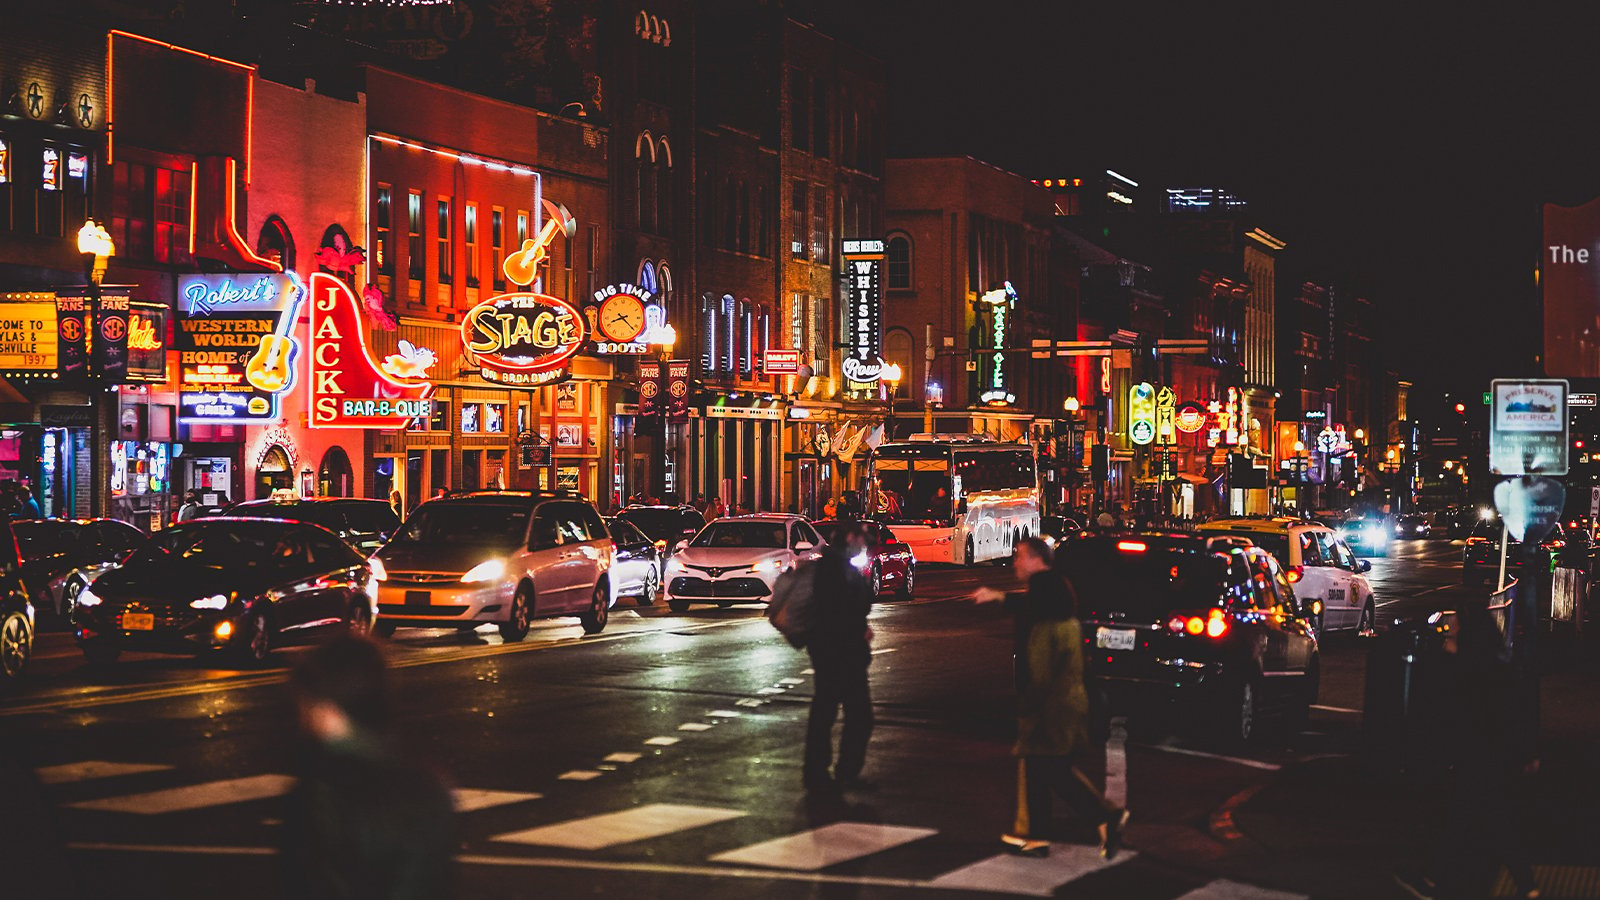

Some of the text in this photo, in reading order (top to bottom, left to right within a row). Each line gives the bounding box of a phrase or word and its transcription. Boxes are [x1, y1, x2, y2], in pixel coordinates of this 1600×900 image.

[1549, 246, 1589, 264] The
[184, 275, 277, 317] Robert's
[594, 283, 651, 302] BIG TIME
[57, 302, 84, 311] FANS
[101, 301, 130, 311] FANS
[855, 261, 872, 360] WHISKEY
[30, 320, 43, 330] TO
[62, 320, 80, 339] SEC
[104, 318, 124, 339] SEC
[180, 319, 273, 333] WESTERN
[469, 305, 580, 353] STAGE
[31, 332, 37, 342] &
[193, 334, 261, 347] WORLD
[315, 287, 345, 422] JACKS
[597, 342, 647, 353] BOOTS
[24, 355, 47, 366] 1997
[182, 351, 251, 367] HOME of
[481, 367, 563, 383] ON BROADWAY
[845, 358, 882, 377] Row
[205, 384, 224, 392] Tonk
[225, 384, 253, 392] Heaven
[343, 400, 430, 417] BAR-B-QUE
